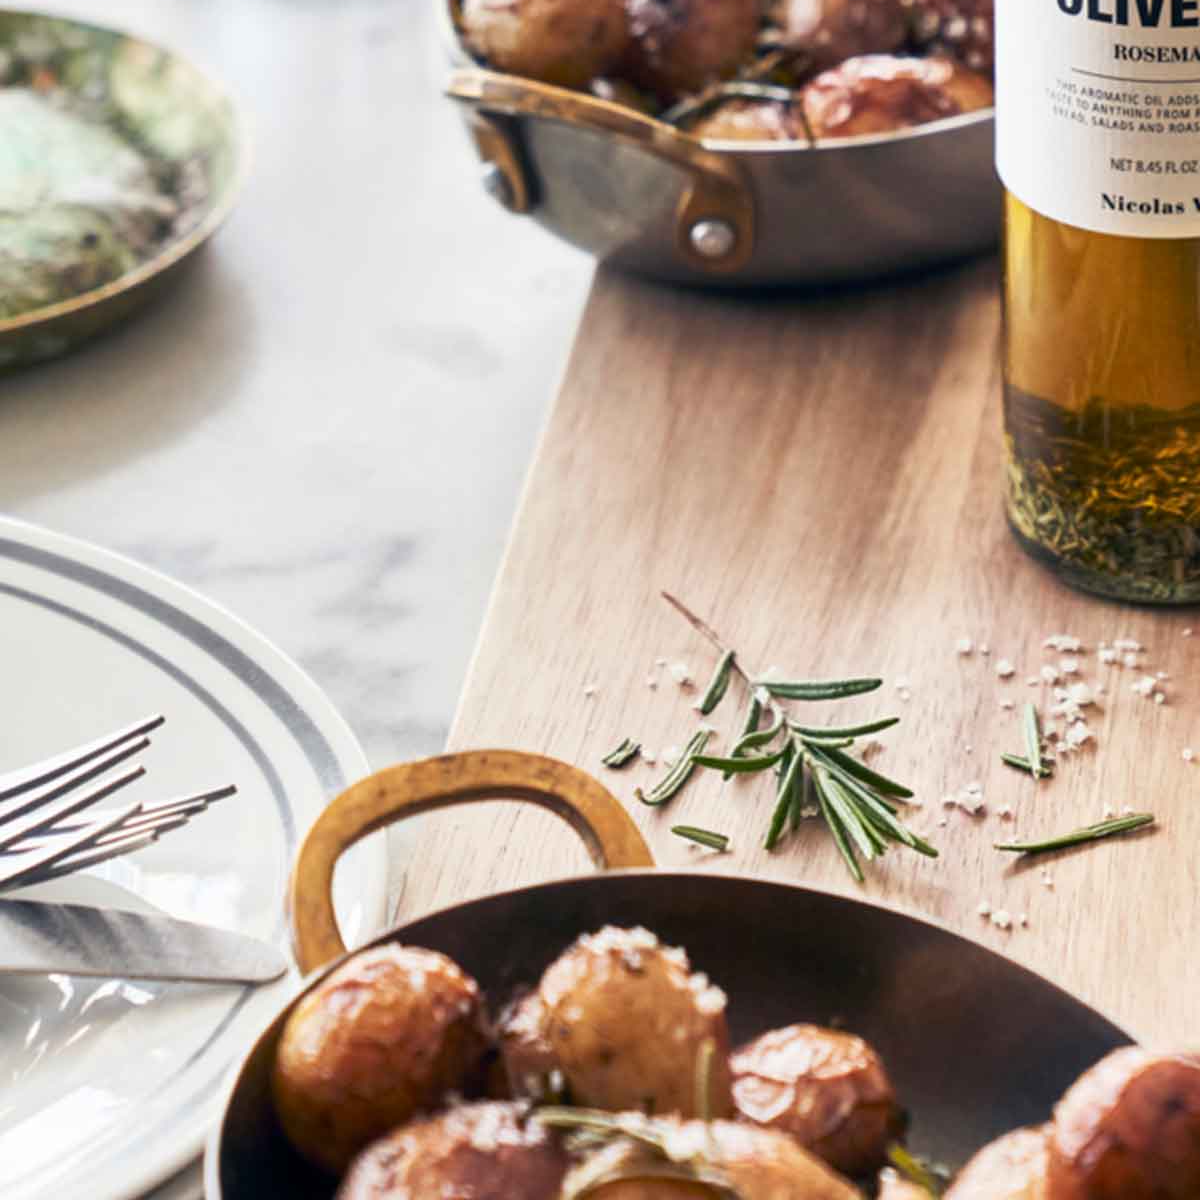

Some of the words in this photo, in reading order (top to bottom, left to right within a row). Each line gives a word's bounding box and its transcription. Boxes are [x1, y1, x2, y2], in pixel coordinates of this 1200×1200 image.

[1080, 86, 1140, 105] AROMATIC
[1144, 93, 1164, 106] OIL
[1167, 93, 1200, 106] ADDS
[1091, 102, 1153, 120] ANYTHING
[1156, 107, 1191, 119] FROM
[1091, 114, 1135, 132] SALADS
[1138, 121, 1165, 134] AND
[1110, 156, 1133, 173] NET
[1164, 159, 1179, 175] FL
[1180, 158, 1199, 174] OZ
[1099, 191, 1186, 215] Nicolas
